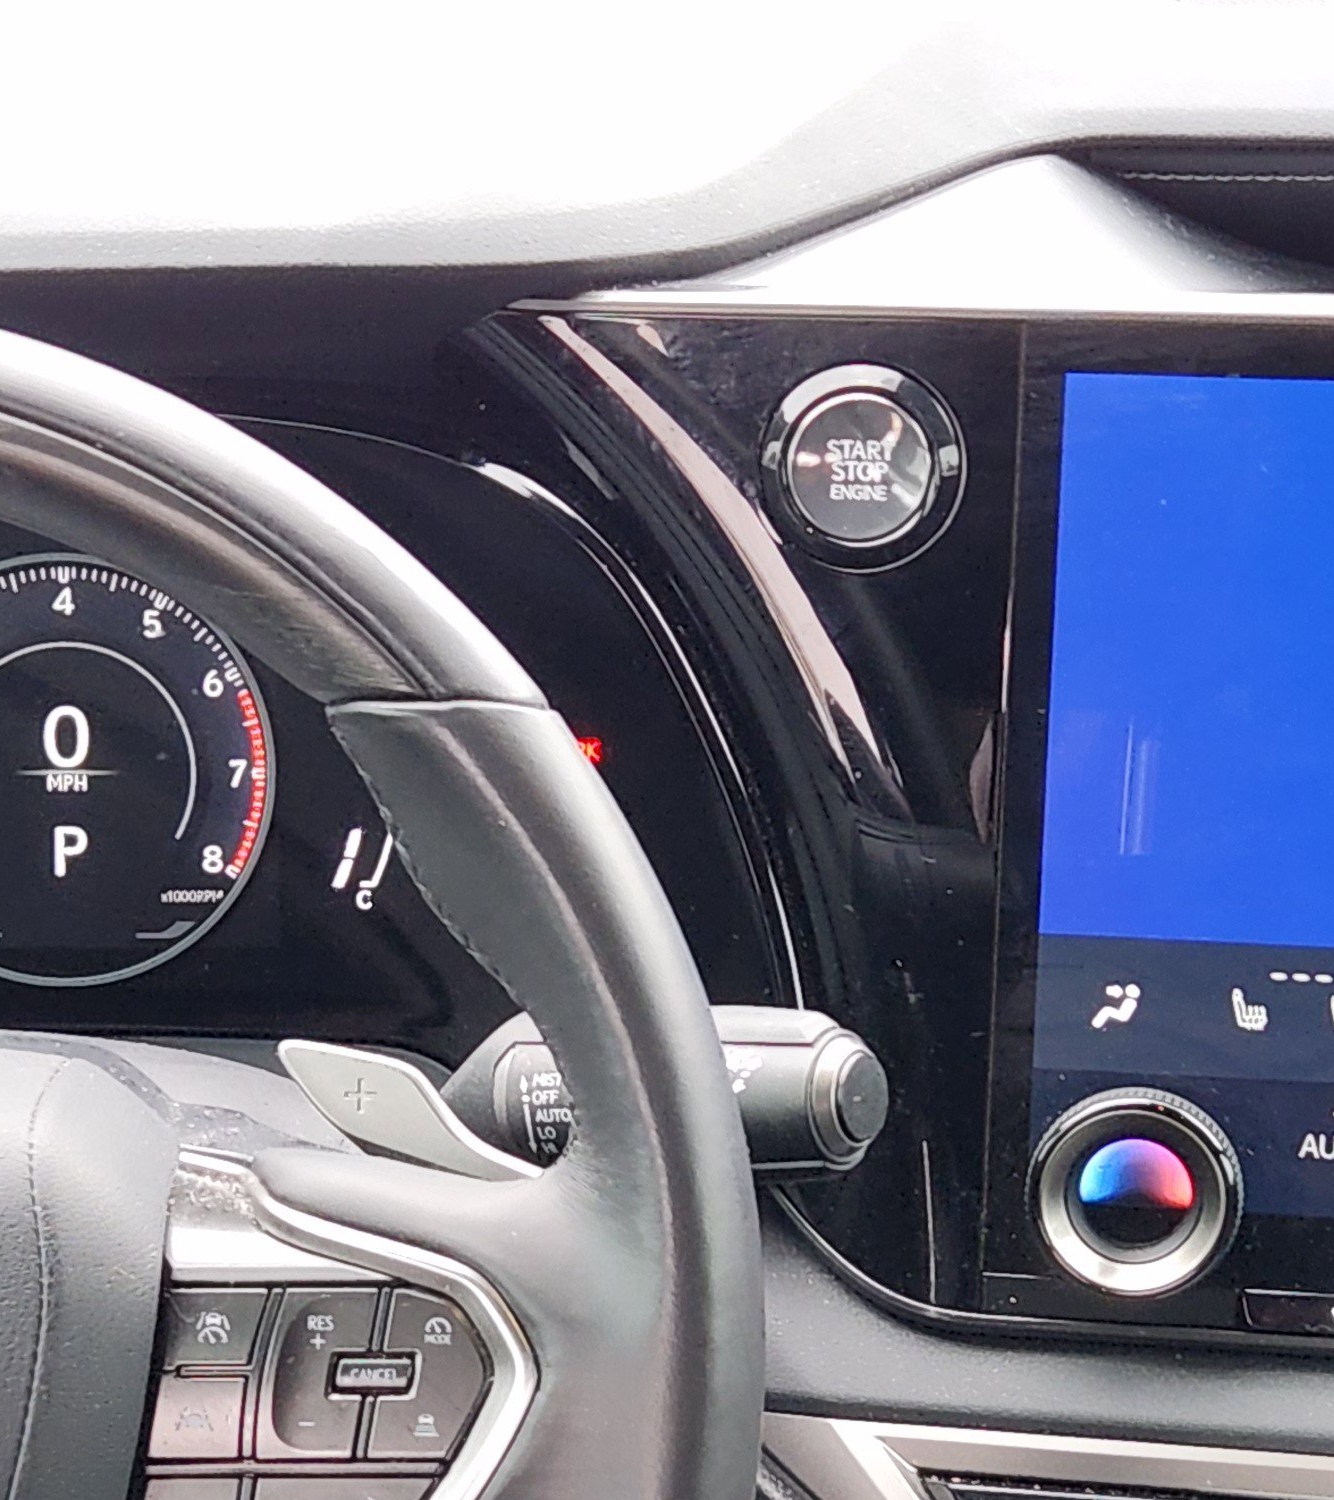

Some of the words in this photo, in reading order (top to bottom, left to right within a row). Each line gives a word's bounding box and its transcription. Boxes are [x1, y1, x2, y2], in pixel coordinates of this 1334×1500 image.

[826, 438, 892, 461] START
[830, 461, 891, 482] STOP
[829, 484, 888, 502] ENGINE
[52, 588, 75, 615] 4
[142, 611, 164, 638] 5
[203, 670, 224, 697] 6
[43, 705, 89, 768] 0
[46, 774, 88, 792] MPH
[228, 760, 248, 789] 7
[53, 825, 88, 877] P
[202, 845, 224, 873] 8
[355, 890, 373, 910] C
[532, 1089, 560, 1106] OFF
[535, 1107, 572, 1123] AUTO
[536, 1125, 557, 1140] LO
[306, 1315, 335, 1332] RES
